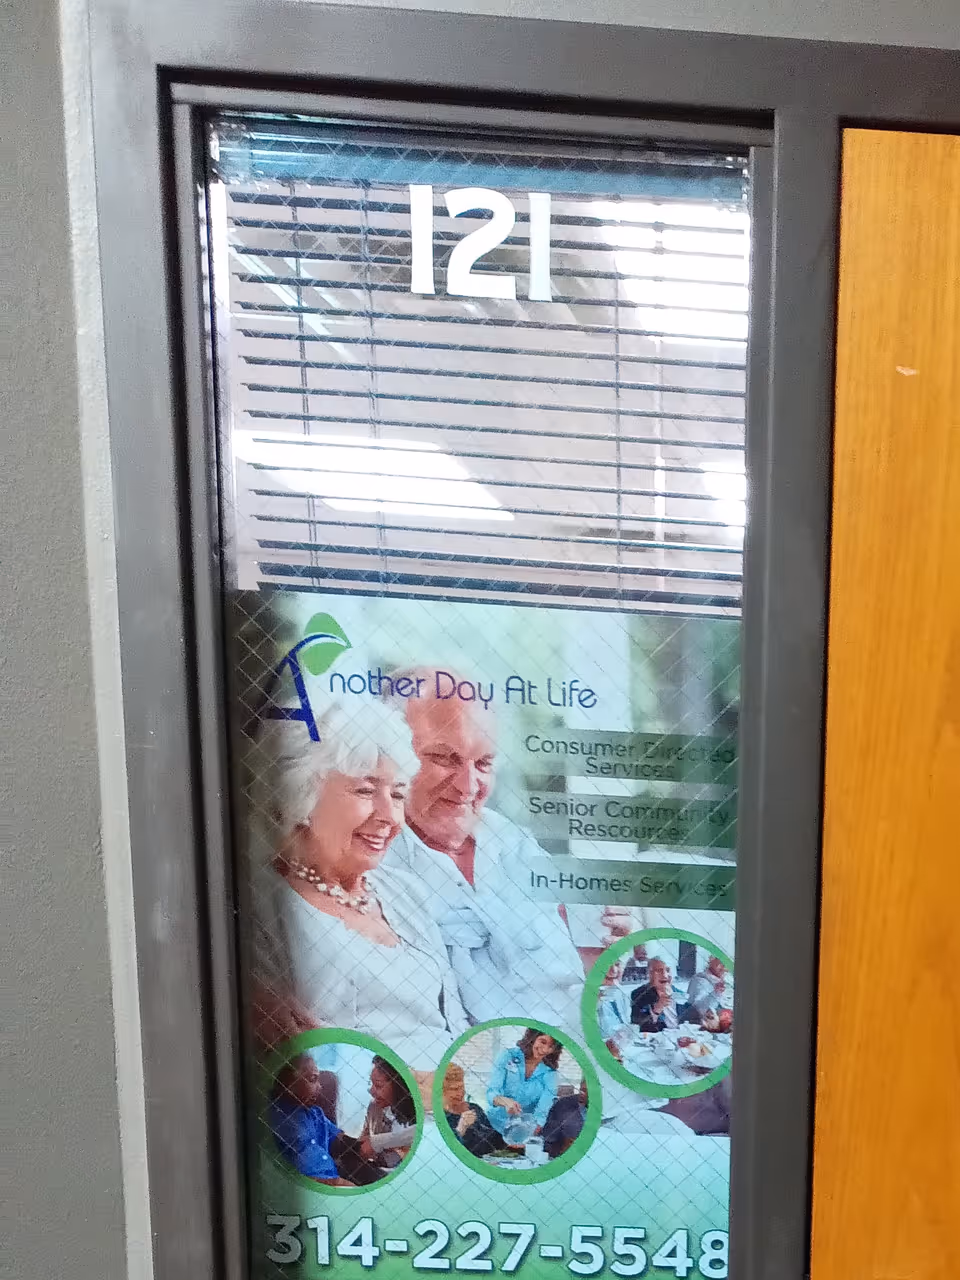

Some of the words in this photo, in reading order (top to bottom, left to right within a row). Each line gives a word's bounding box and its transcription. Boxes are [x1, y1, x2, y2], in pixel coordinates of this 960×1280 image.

[409, 183, 553, 302] 121
[435, 670, 495, 711] Day
[504, 675, 538, 706] At
[547, 677, 598, 709] Life
[525, 734, 638, 758] Consumer
[585, 756, 677, 778] Services
[529, 796, 599, 818] Senior
[530, 870, 633, 893] In-Homes
[265, 1213, 729, 1280] 314-227-5548
